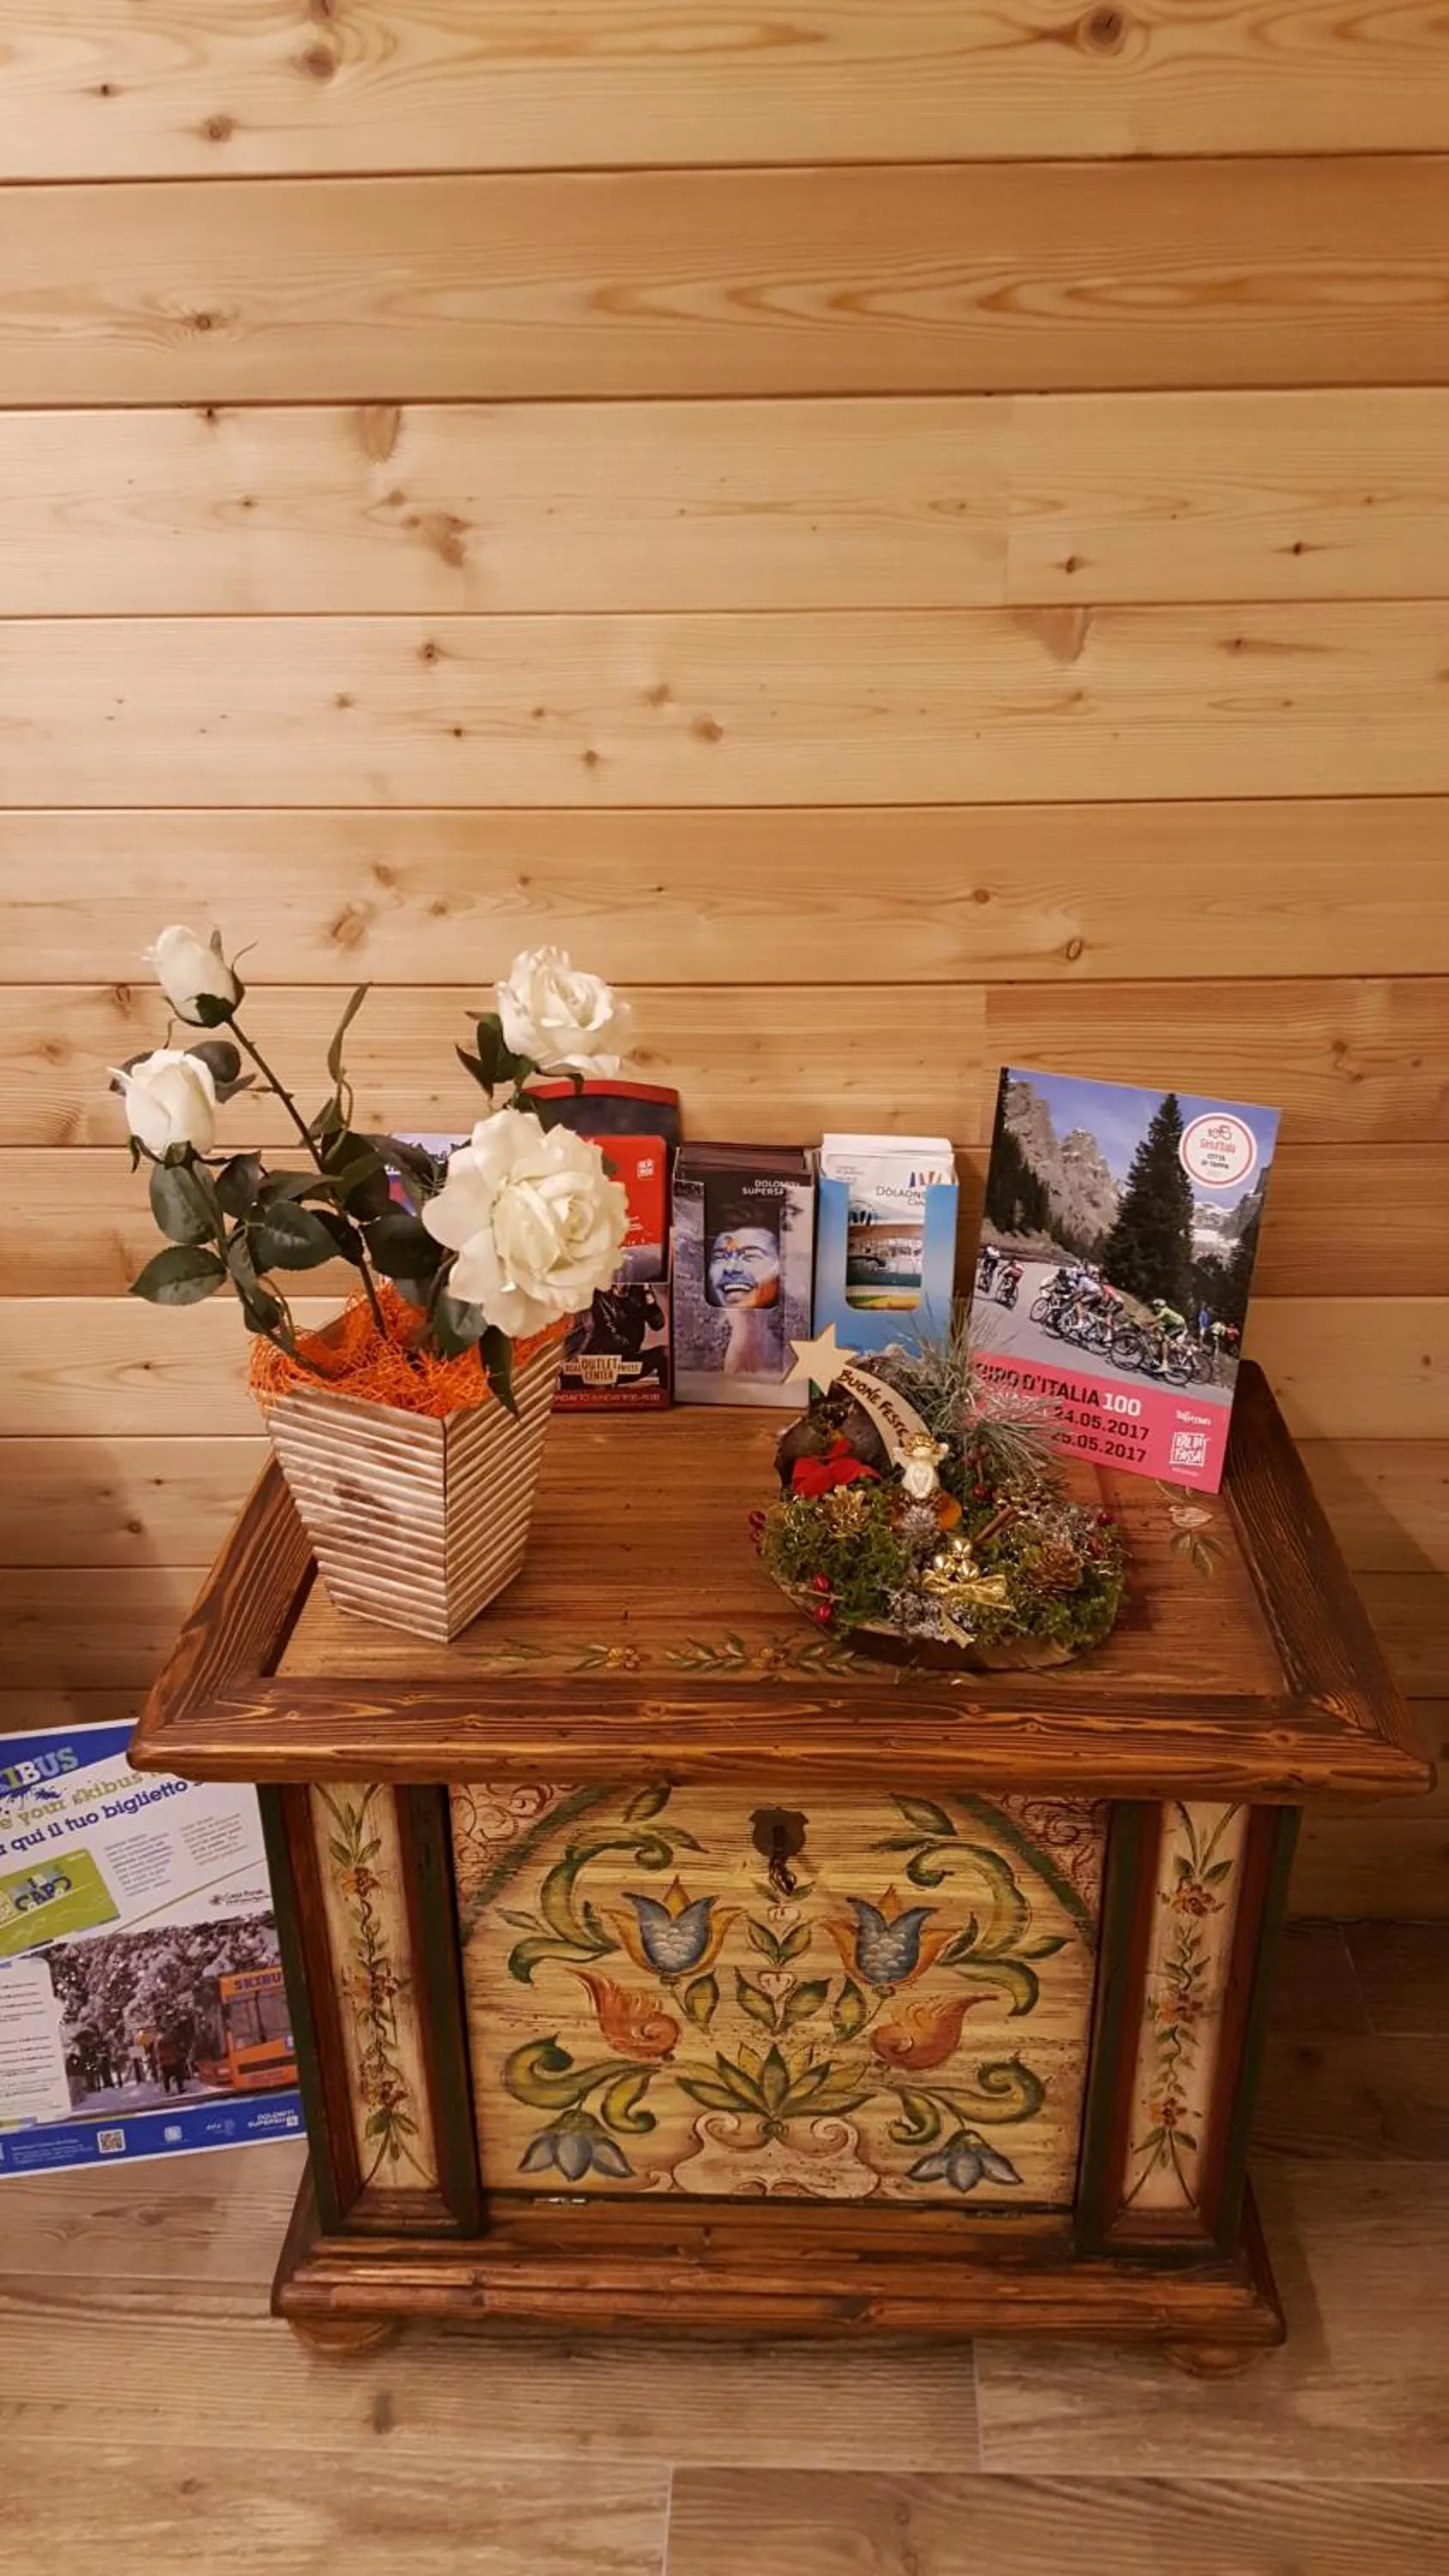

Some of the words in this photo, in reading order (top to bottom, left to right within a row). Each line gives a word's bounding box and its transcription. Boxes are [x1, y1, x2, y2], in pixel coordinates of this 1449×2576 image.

[1101, 1393, 1141, 1417] 100
[11, 1828, 46, 1852] qui
[48, 1822, 64, 1838] il
[64, 1812, 100, 1832] tuo
[101, 1779, 188, 1820] biglietto
